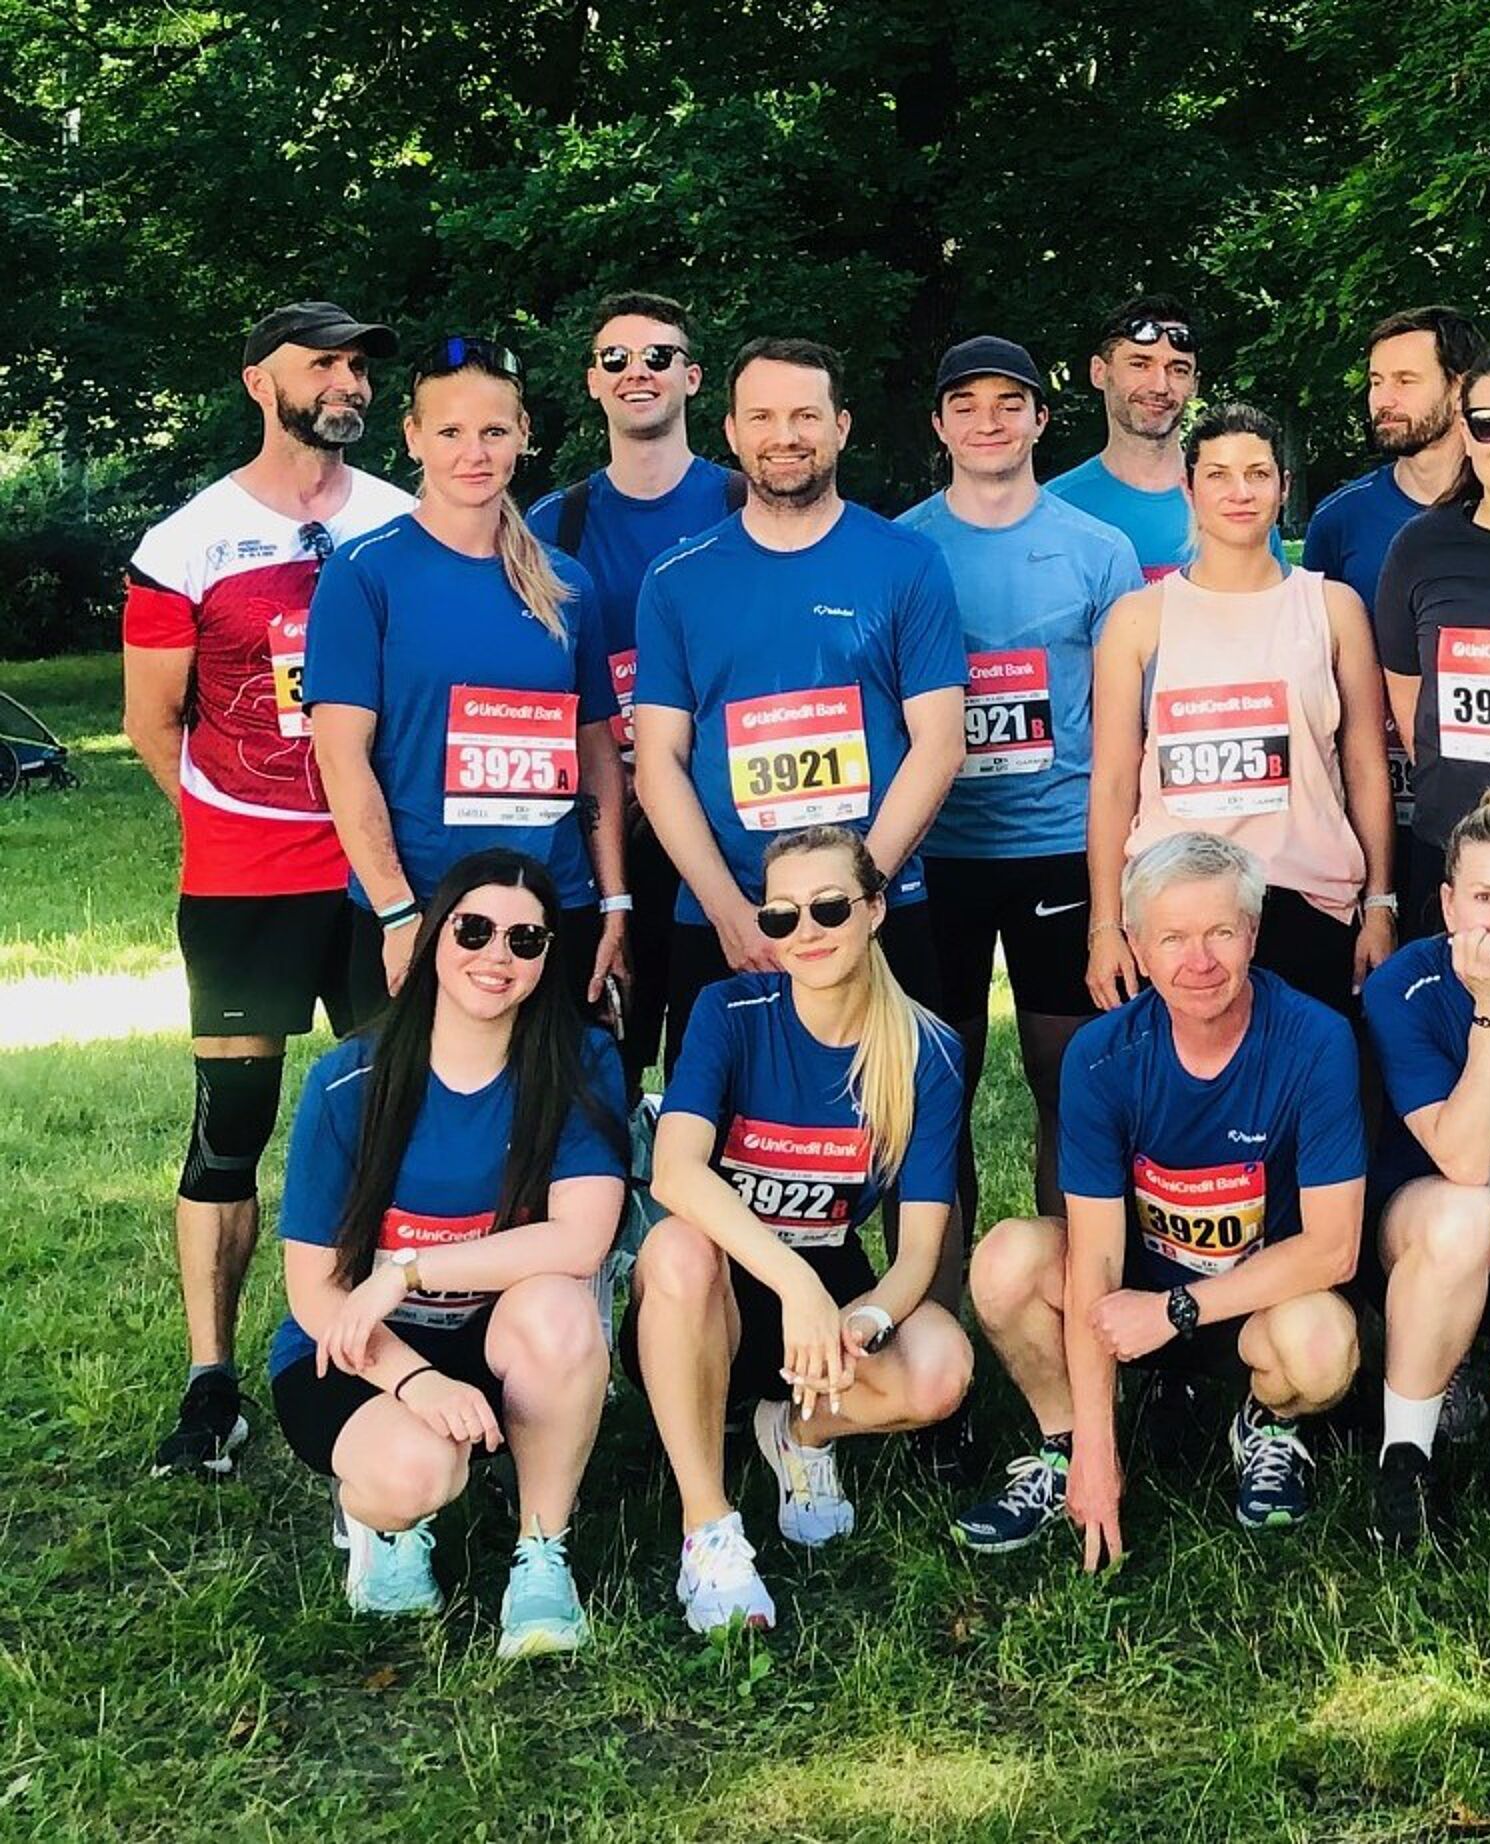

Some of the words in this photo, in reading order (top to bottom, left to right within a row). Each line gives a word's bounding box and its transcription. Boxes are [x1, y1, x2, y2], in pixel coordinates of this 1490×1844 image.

[969, 663, 1004, 679] Credit
[1006, 662, 1034, 676] Bank
[480, 702, 532, 720] UniCredit
[533, 705, 563, 721] Bank
[757, 704, 815, 725] UniCredit
[815, 701, 847, 717] Bank
[1242, 695, 1274, 710] Bank
[965, 704, 1028, 745] 921
[1032, 719, 1044, 739] B
[459, 746, 555, 791] 3925
[557, 769, 569, 791] A
[747, 747, 841, 796] 3921
[1169, 739, 1267, 786] 3925
[1269, 755, 1282, 777] B
[760, 1137, 822, 1155] UniCredit
[823, 1141, 857, 1157] Bank
[731, 1172, 834, 1219] 3922
[1156, 1173, 1214, 1194] UniCredit
[1216, 1174, 1250, 1190] Bank
[415, 1227, 481, 1242] UniCredit
[1147, 1203, 1242, 1249] 3920
